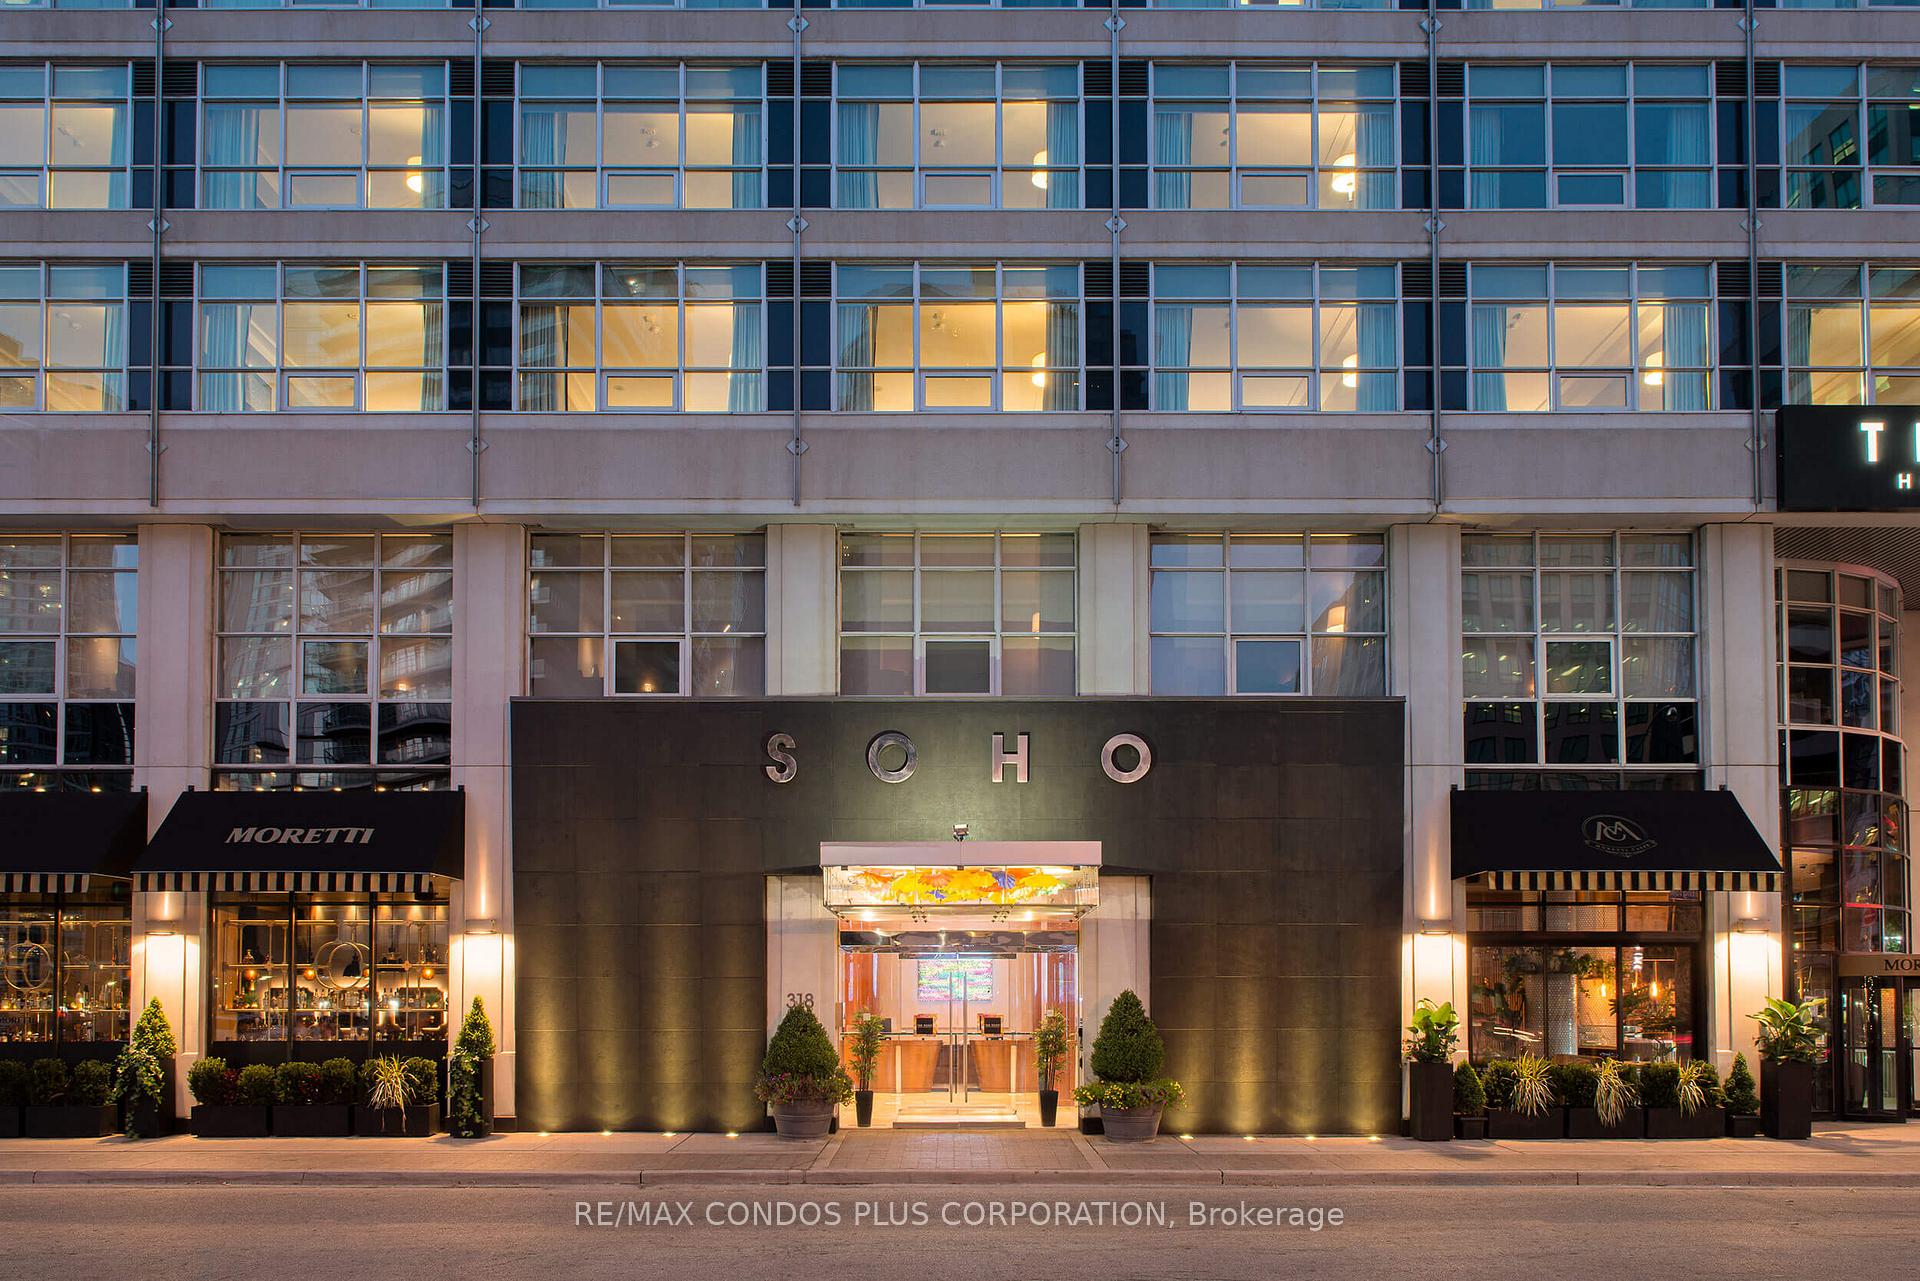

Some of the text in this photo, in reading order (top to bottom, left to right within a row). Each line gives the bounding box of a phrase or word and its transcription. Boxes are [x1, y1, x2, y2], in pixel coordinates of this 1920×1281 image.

[1860, 422, 1920, 462] T
[765, 732, 1152, 784] SOHO
[225, 827, 375, 844] MORETTI
[786, 993, 814, 1009] 318
